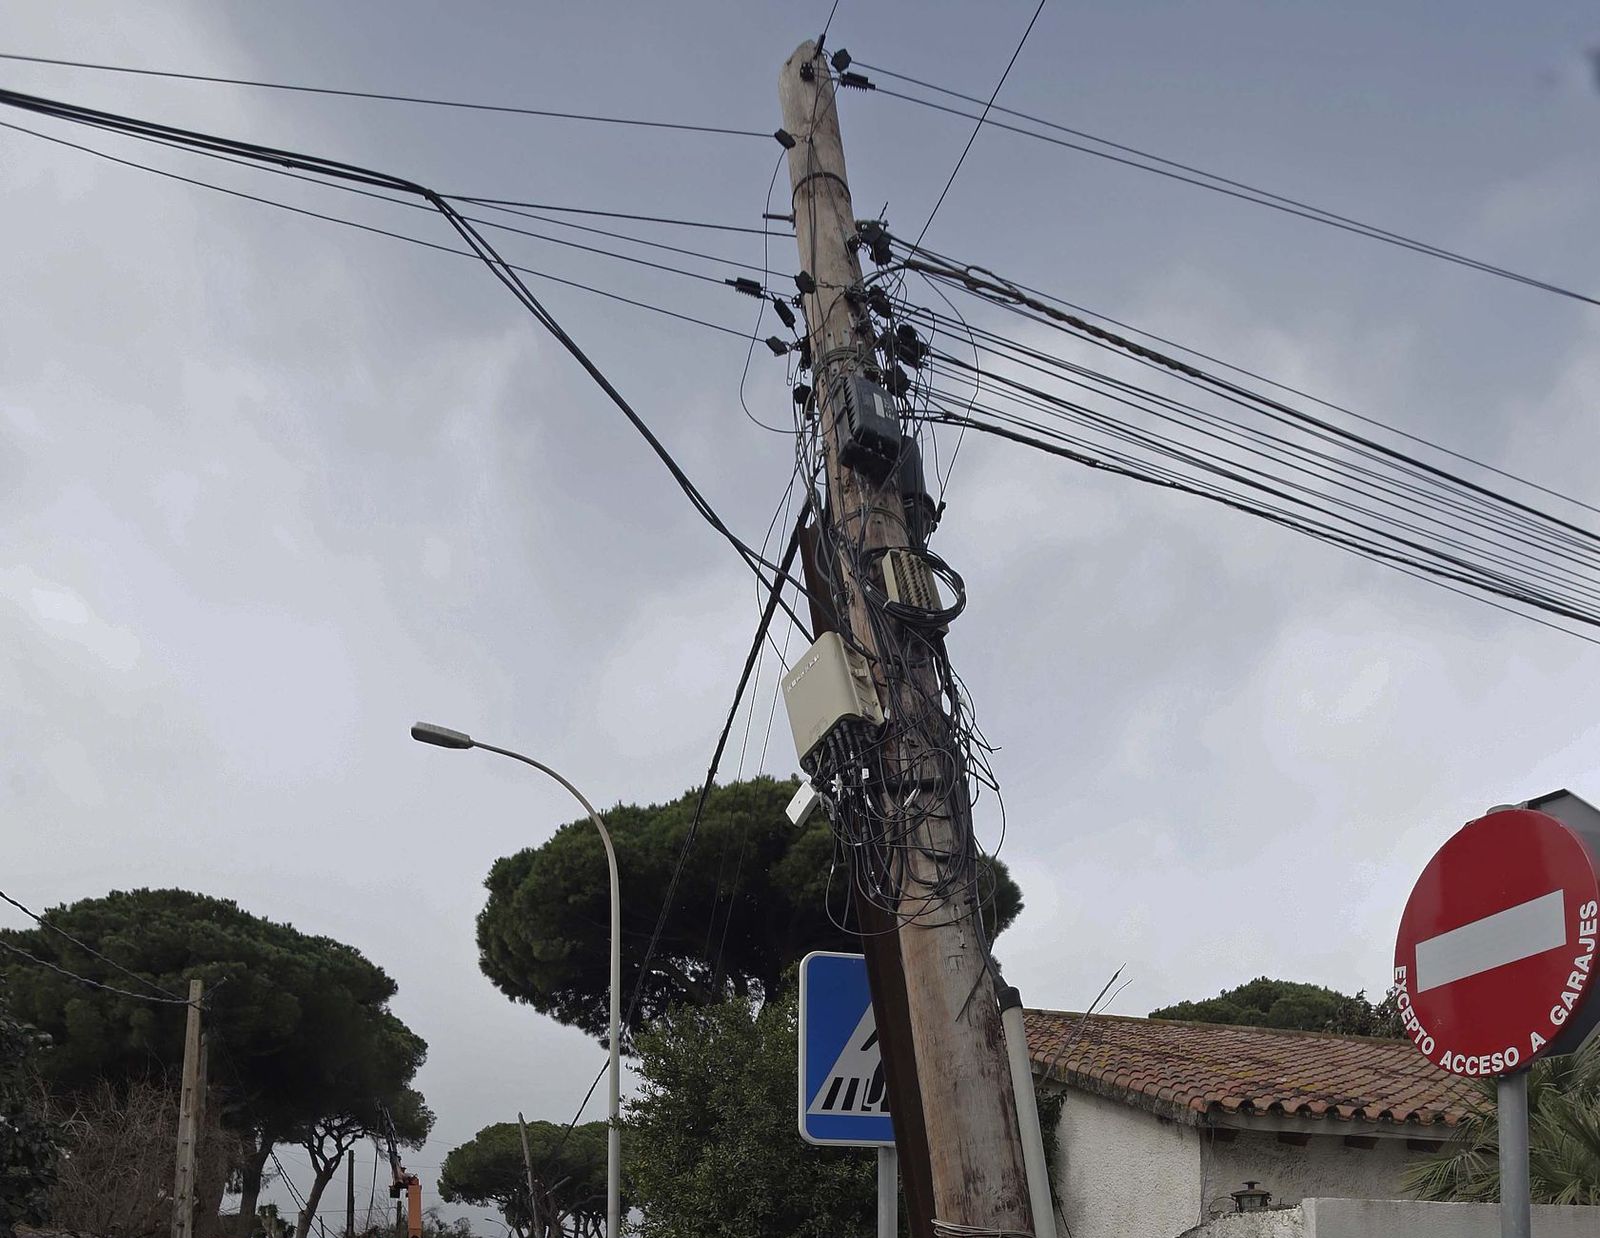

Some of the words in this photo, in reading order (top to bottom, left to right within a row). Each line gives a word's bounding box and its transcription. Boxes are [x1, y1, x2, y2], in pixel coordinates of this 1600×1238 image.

[1394, 966, 1435, 1054] EXCEPTO
[1440, 1046, 1519, 1075] ACCESO
[1530, 1031, 1546, 1052] A
[1549, 900, 1598, 1025] GARAJES
